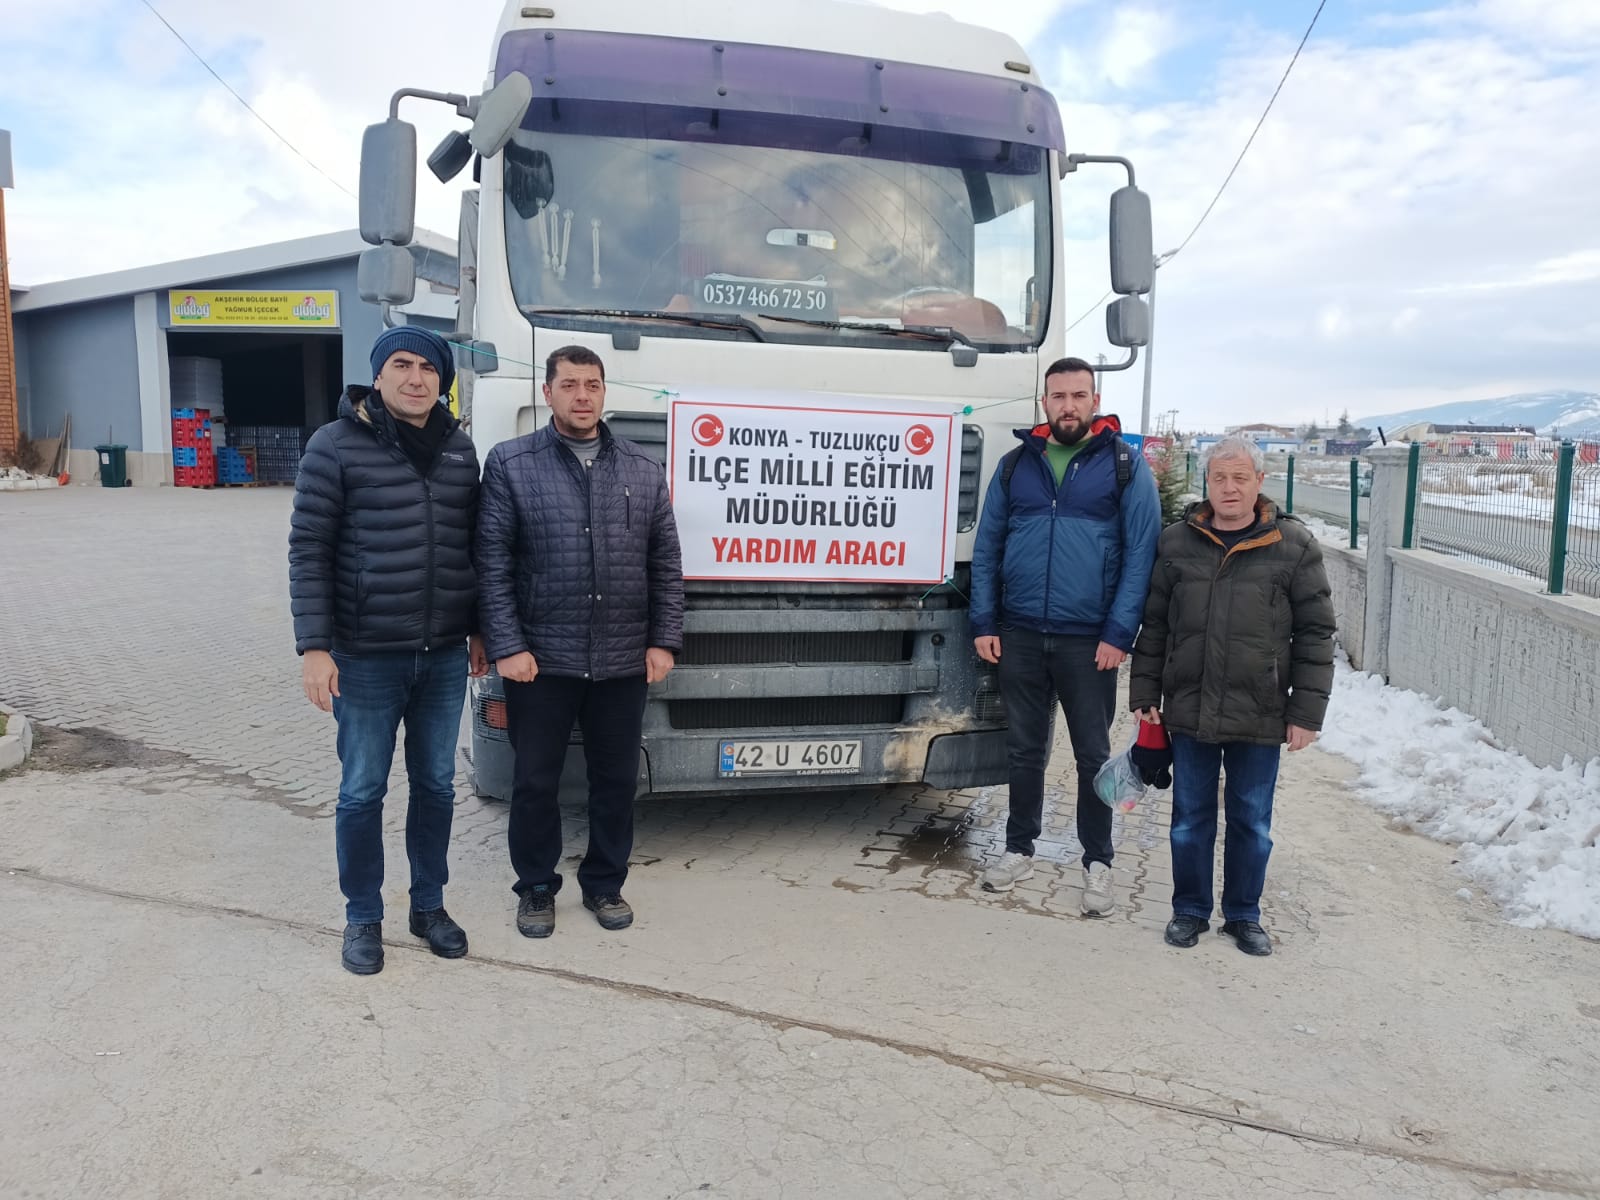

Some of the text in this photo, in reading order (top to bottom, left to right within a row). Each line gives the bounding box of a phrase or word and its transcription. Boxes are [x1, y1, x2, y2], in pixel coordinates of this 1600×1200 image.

[254, 306, 280, 314] İÇECEK
[703, 283, 827, 311] 0537 466 72 50
[729, 427, 789, 448] KONYA
[809, 430, 900, 457] TUZLUKÇU
[688, 449, 934, 490] İLÇE MİLLİ EĞİTİM
[726, 492, 897, 528] MÜDÜRLÜĞÜ
[711, 536, 906, 566] YARDIM ARACI
[723, 758, 733, 766] TR
[735, 743, 858, 767] 42 U 4607
